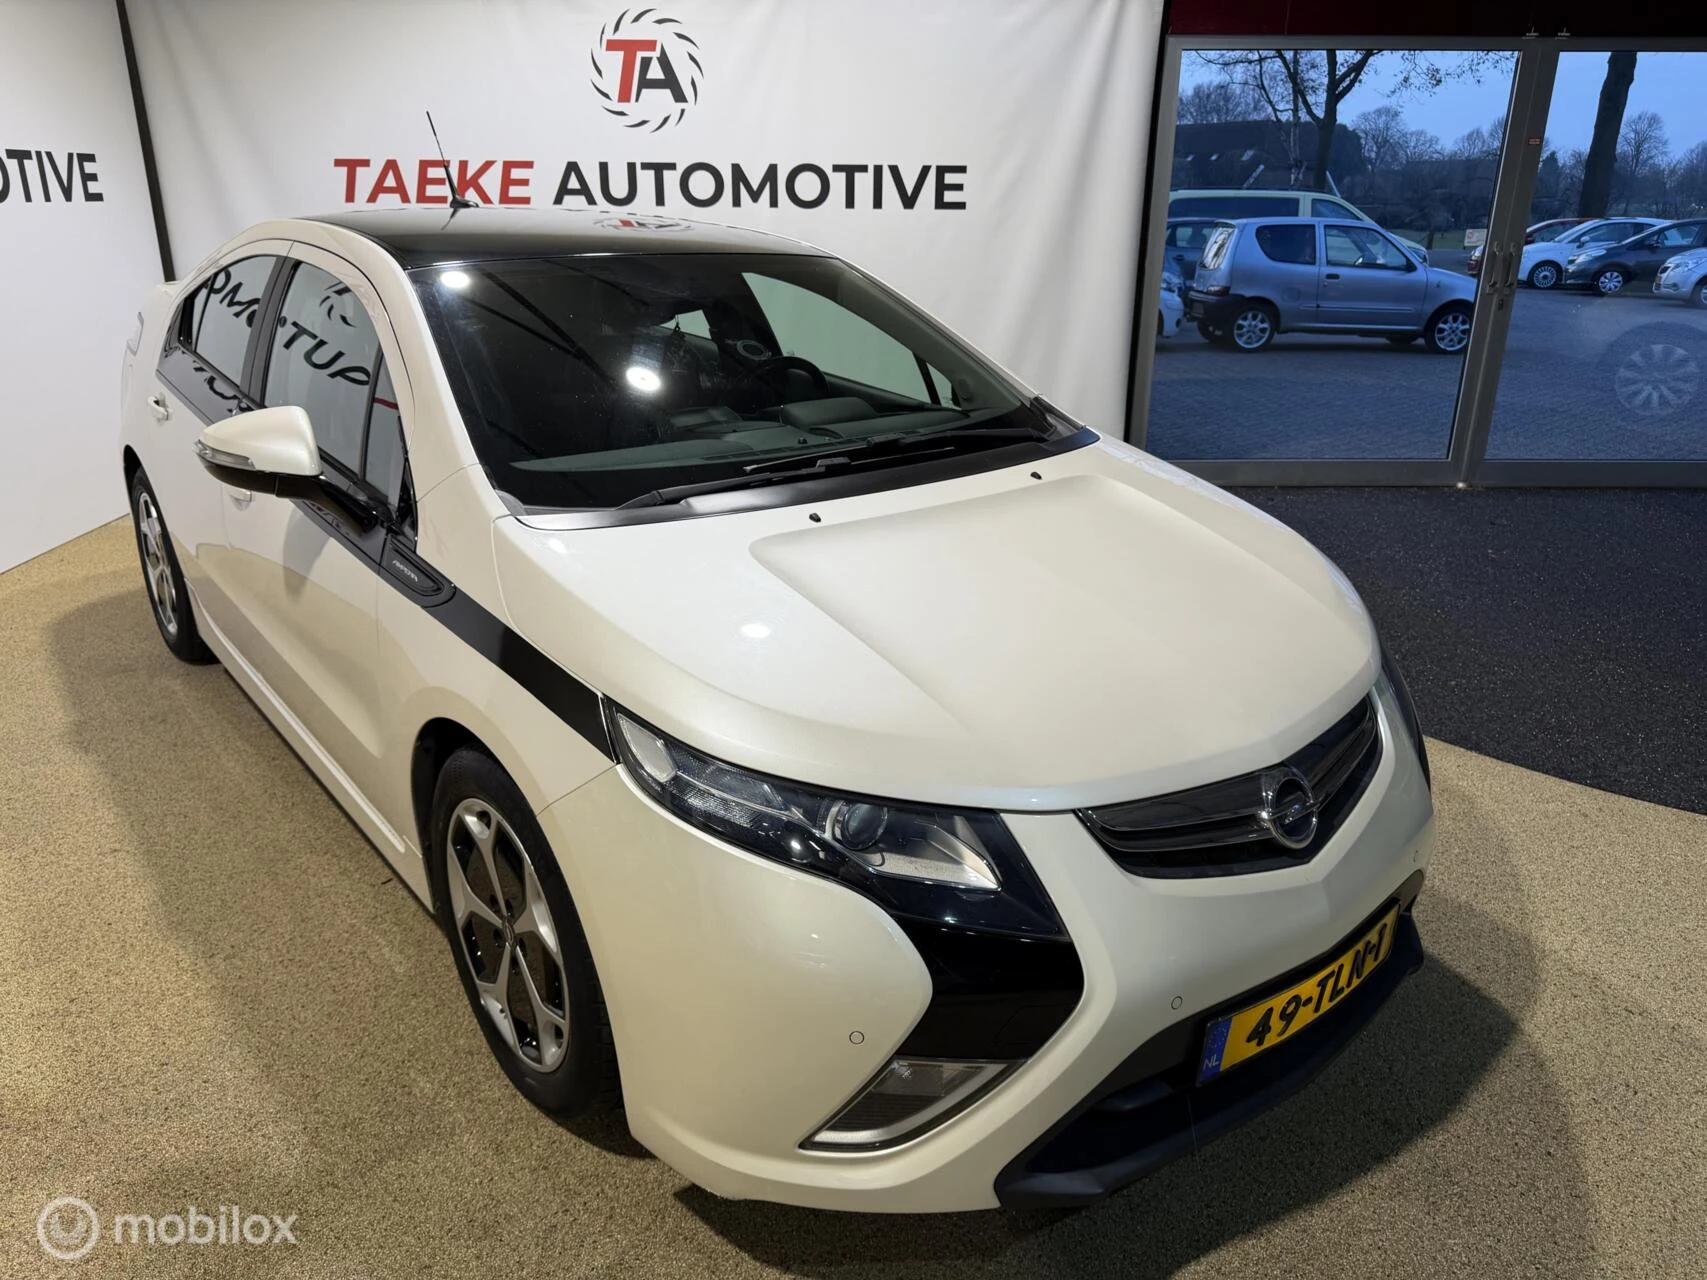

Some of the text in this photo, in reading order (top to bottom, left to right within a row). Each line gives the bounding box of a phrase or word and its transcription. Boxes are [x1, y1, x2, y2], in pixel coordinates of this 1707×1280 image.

[606, 39, 689, 103] TA
[0, 149, 104, 203] TIVE
[334, 158, 967, 210] TAEKE AUTOMOTIVE
[1203, 922, 1387, 1071] NL 49-TLN-1
